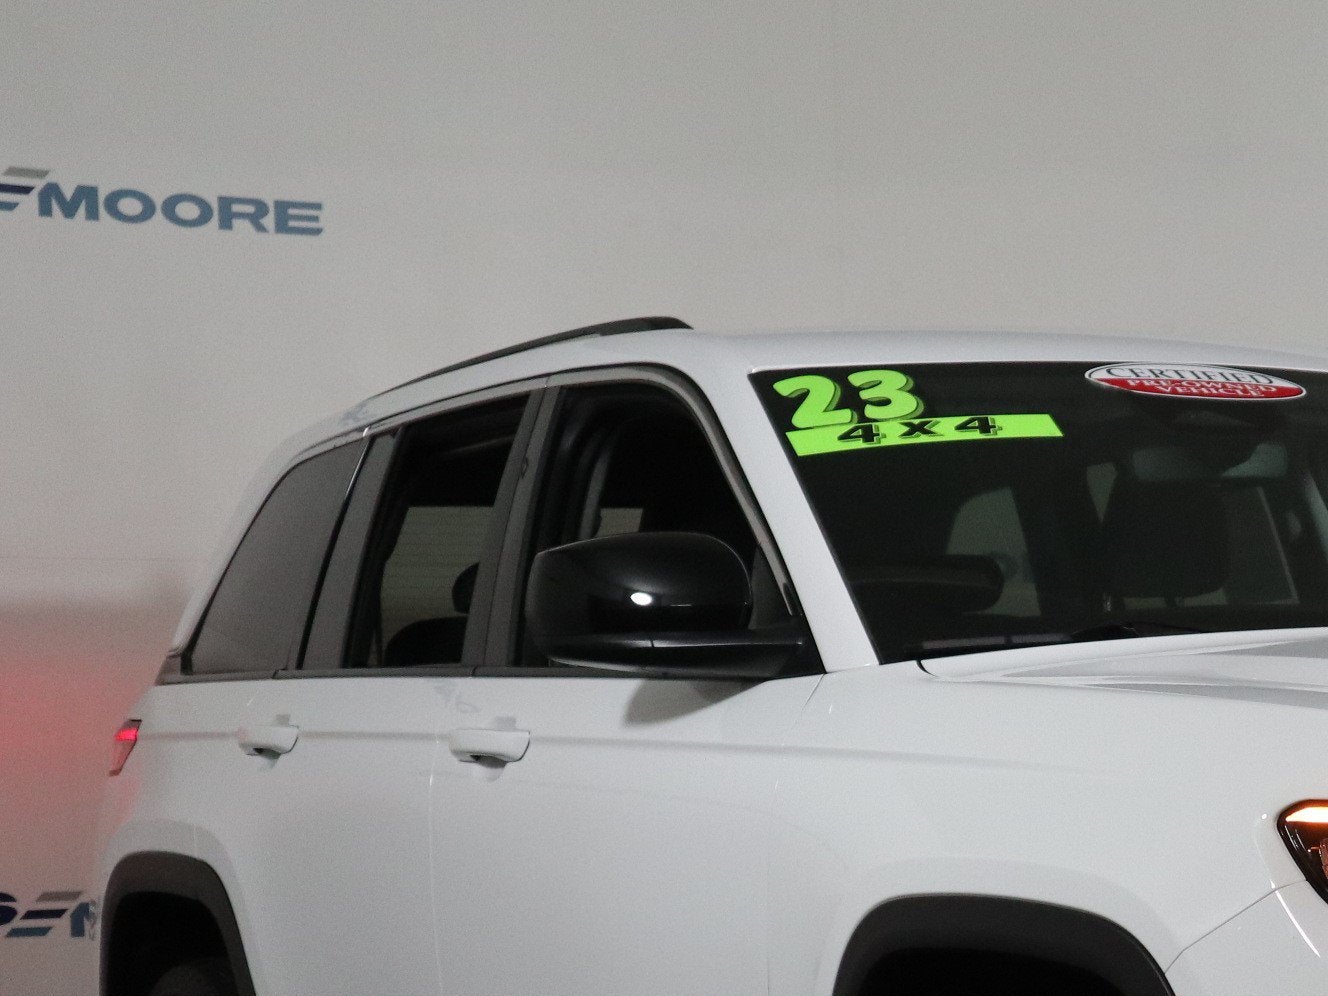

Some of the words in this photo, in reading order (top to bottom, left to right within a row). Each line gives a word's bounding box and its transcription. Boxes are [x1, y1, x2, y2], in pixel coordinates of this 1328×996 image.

[37, 181, 323, 237] MOORE
[1106, 367, 1273, 384] CERTIFIED
[1126, 379, 1277, 392] PRE-OWNED
[1155, 386, 1265, 397] VEHICLE
[773, 369, 925, 429] 23
